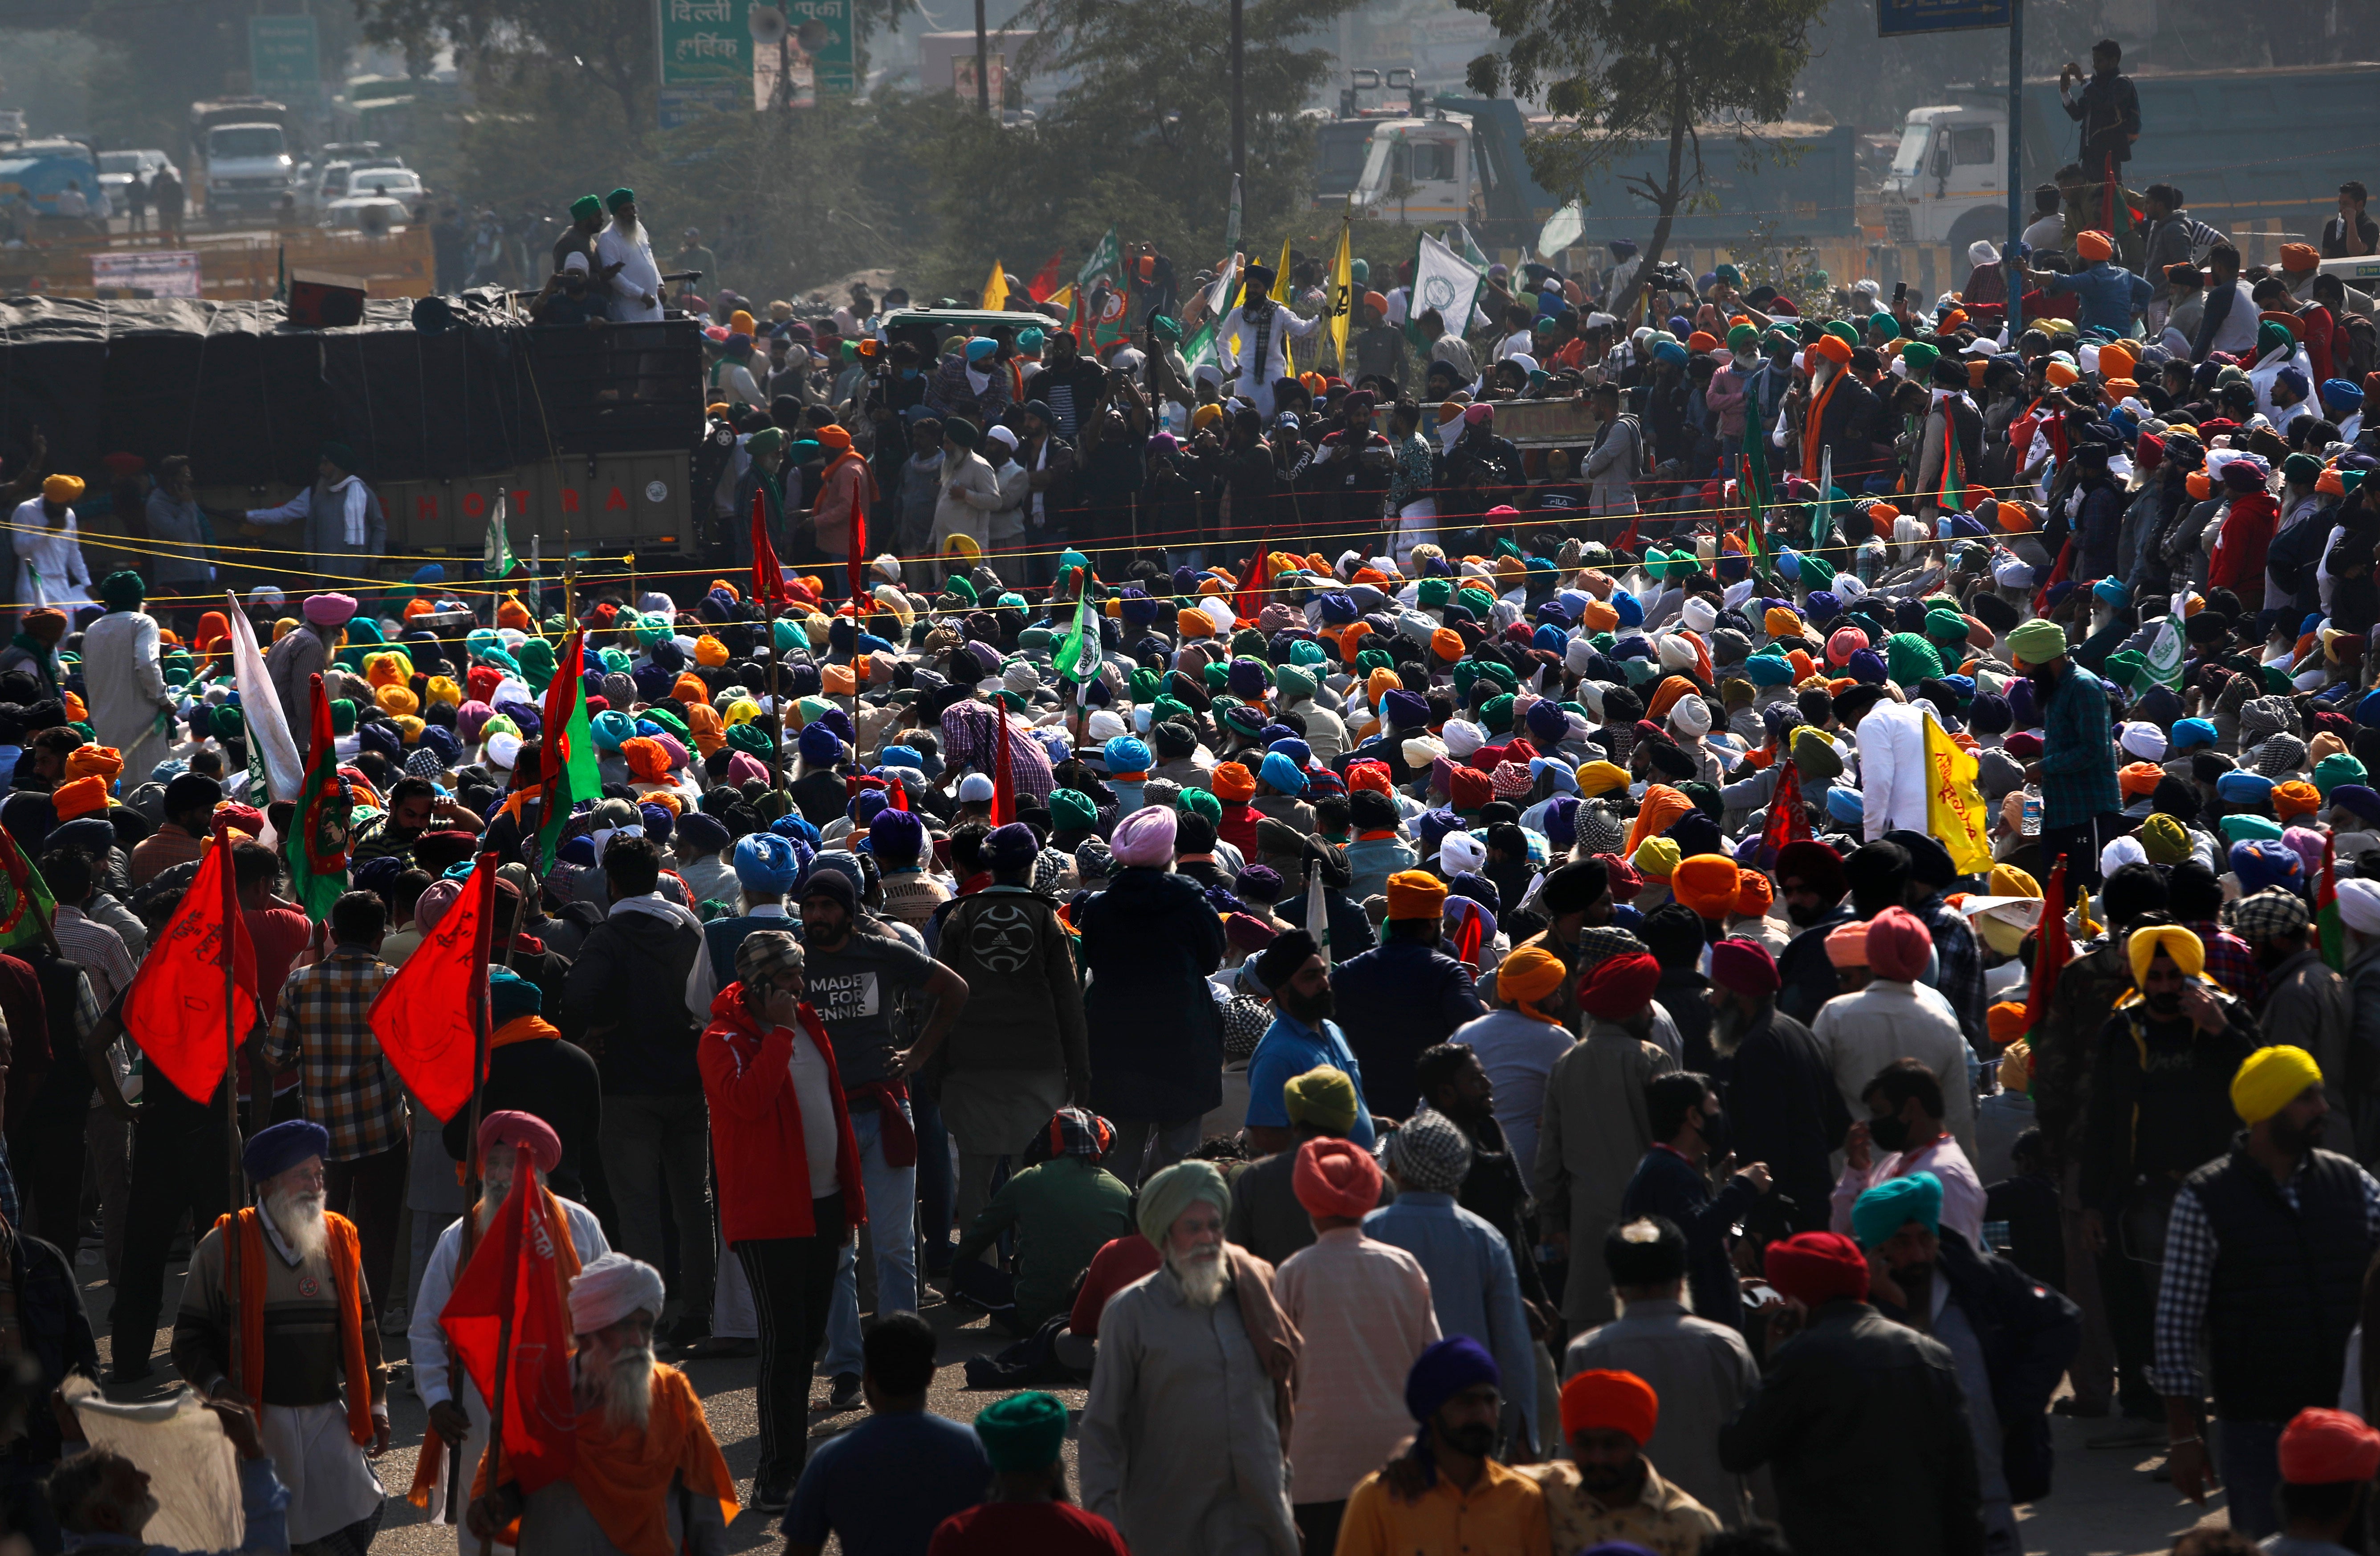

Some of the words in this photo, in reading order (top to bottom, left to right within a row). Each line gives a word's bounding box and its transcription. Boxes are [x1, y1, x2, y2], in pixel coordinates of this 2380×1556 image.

[1281, 413, 1294, 422] GAP
[1549, 498, 1568, 507] FILA
[810, 974, 863, 992] MADE
[829, 989, 863, 1006] FOR
[815, 1003, 866, 1022] ENNIS
